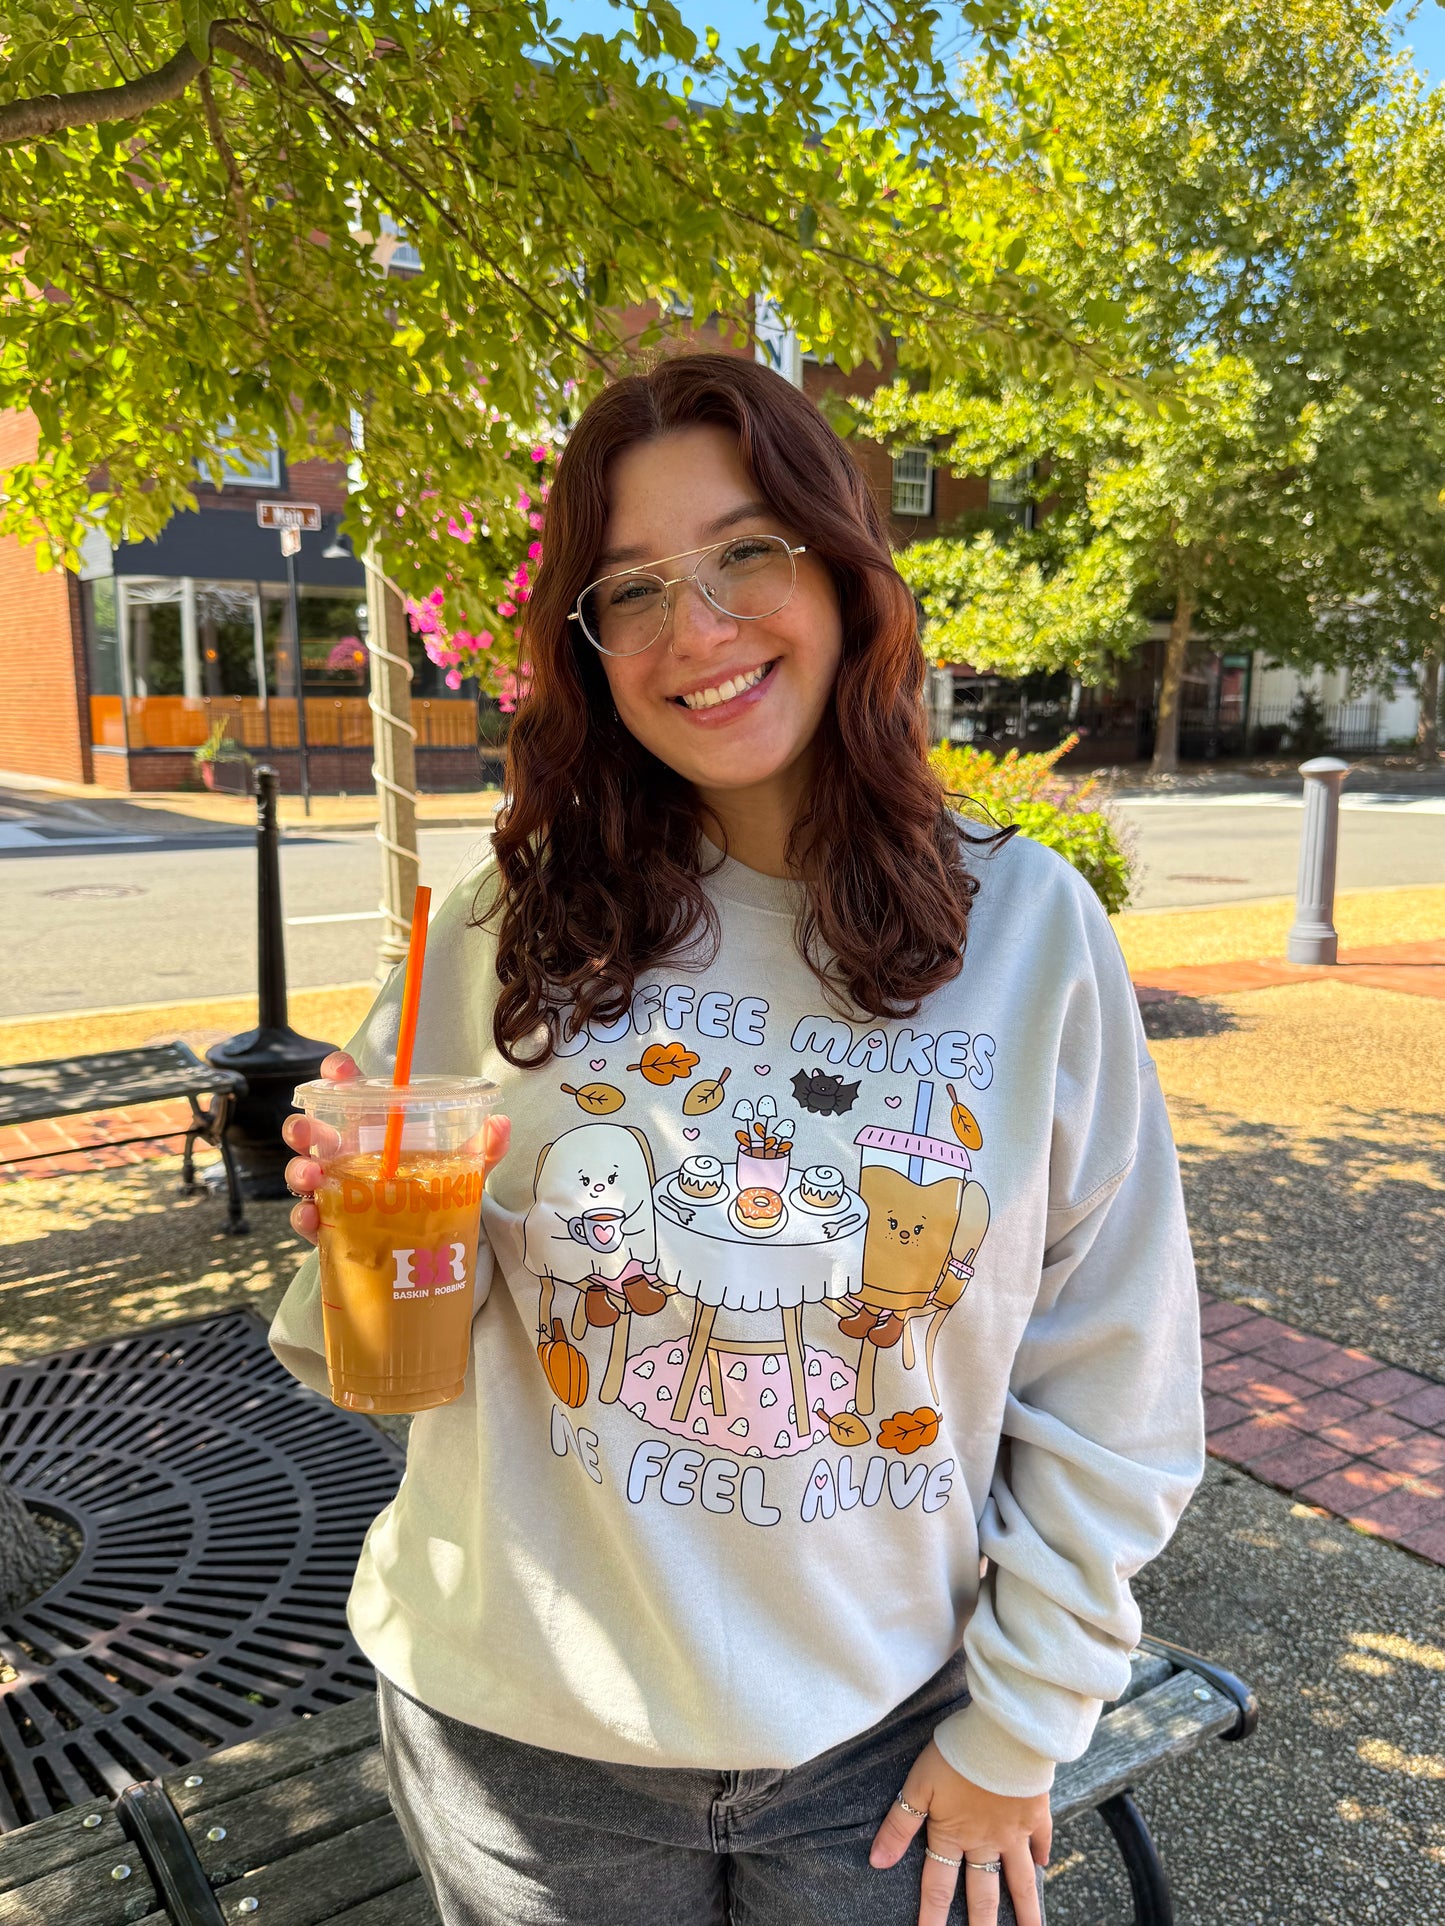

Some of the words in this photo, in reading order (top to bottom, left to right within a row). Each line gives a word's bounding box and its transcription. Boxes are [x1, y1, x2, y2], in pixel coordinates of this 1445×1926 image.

[273, 507, 304, 526] Main
[790, 1014, 997, 1090] MAKES
[392, 1288, 429, 1300] BASKIN
[434, 1280, 467, 1296] ROBBINS
[626, 1439, 781, 1527] FEEL
[800, 1454, 955, 1523] ALIVE
